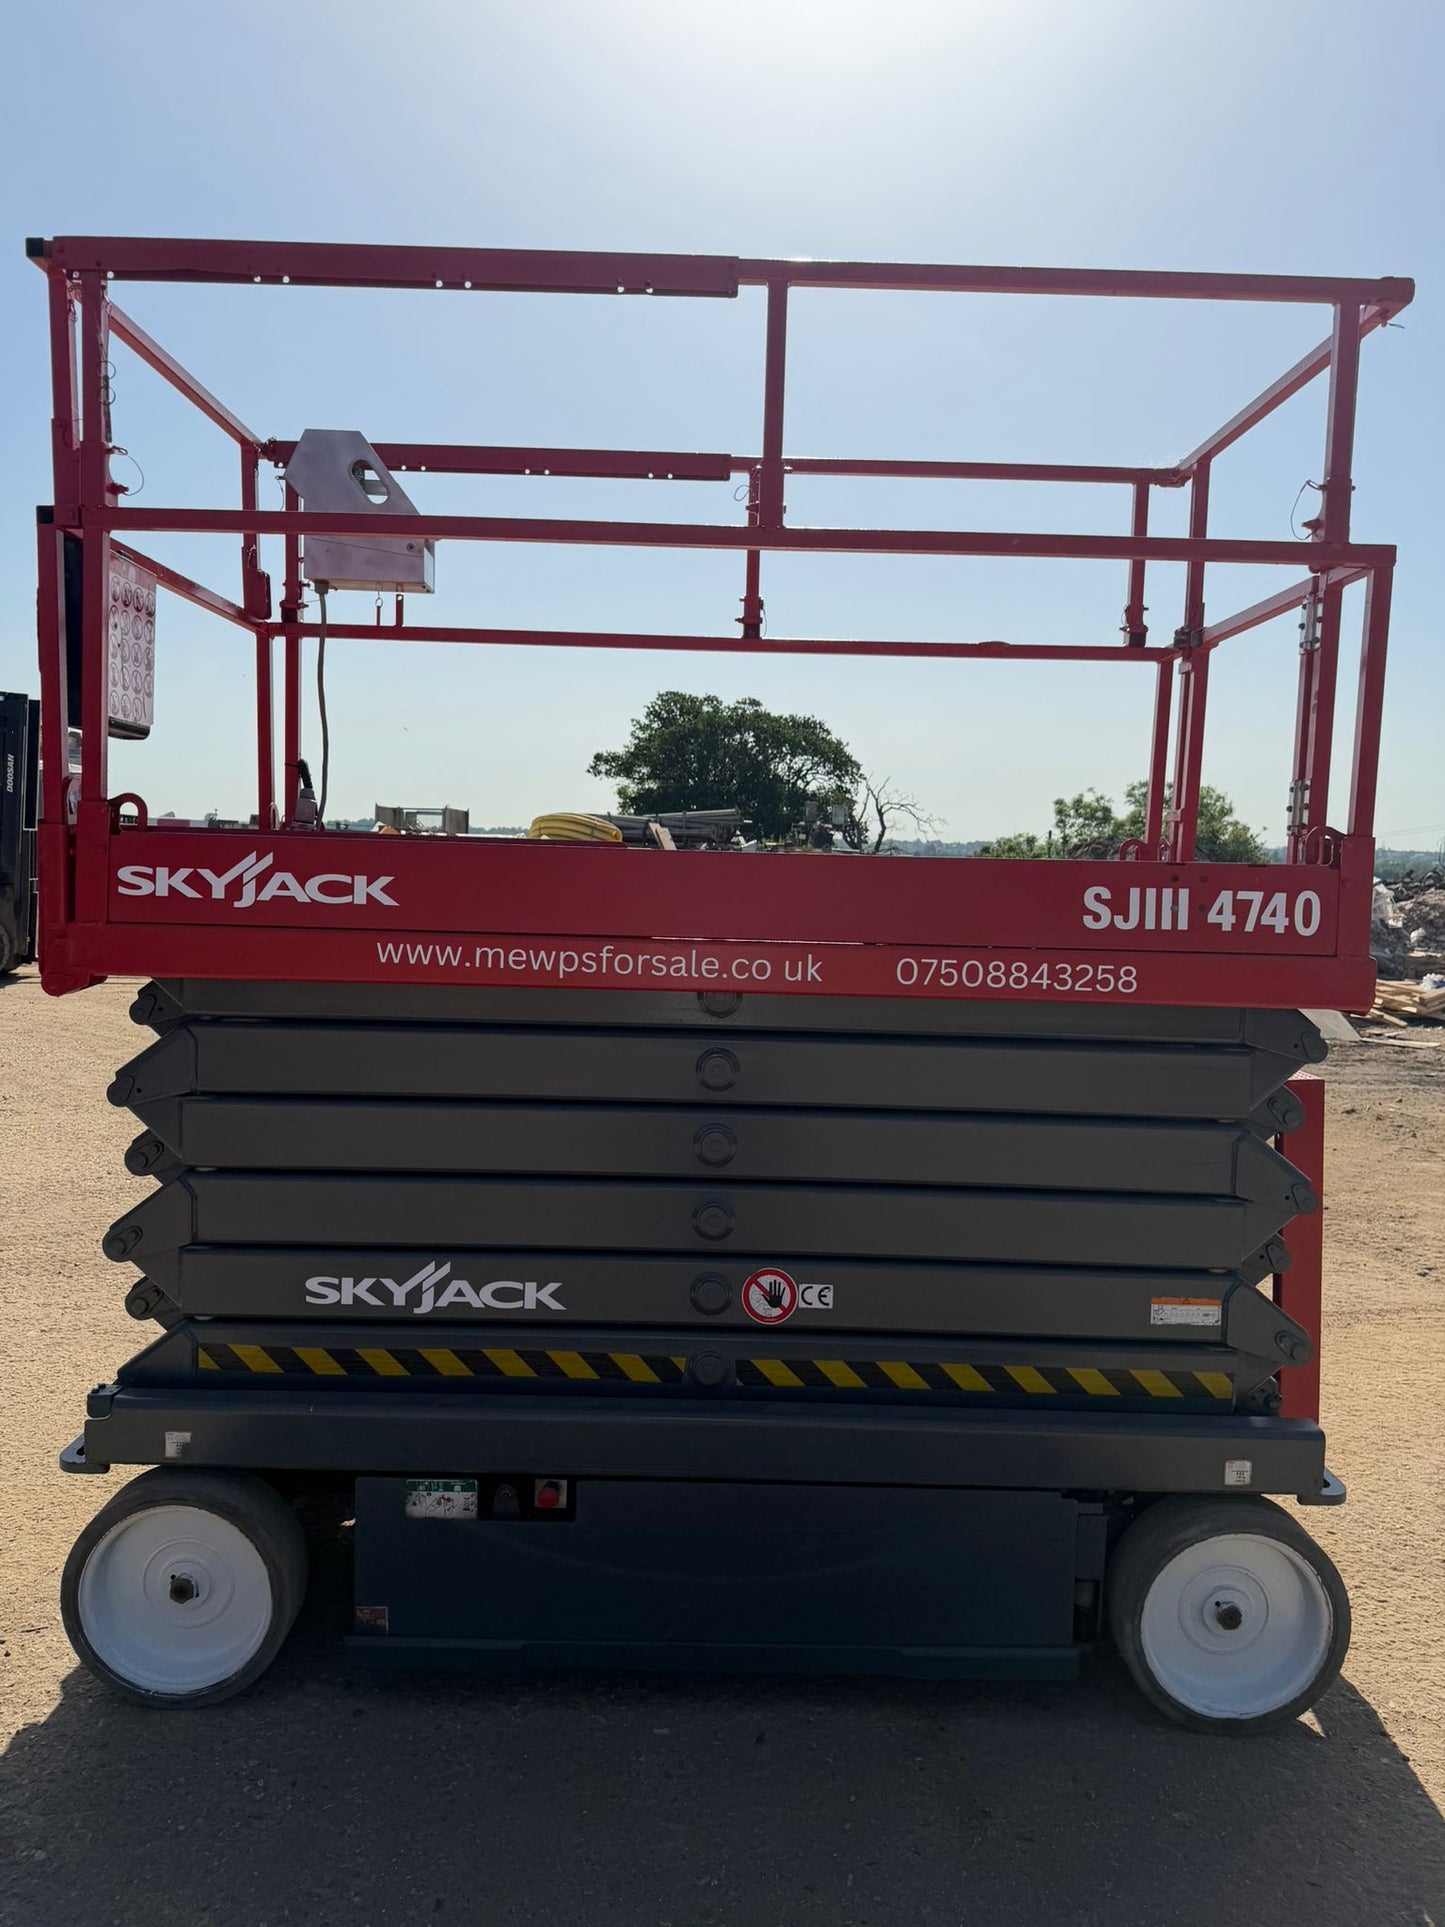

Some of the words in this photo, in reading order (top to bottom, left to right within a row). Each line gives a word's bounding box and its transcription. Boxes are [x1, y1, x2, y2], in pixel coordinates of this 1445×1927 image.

[117, 851, 400, 908] SKYJACK
[1083, 886, 1189, 931] SJIII
[1207, 890, 1321, 936] 4740
[376, 940, 772, 980] www.mewpsforsale.co
[785, 953, 823, 982] uk
[896, 957, 1138, 993] 07508843258
[305, 1261, 567, 1314] SKYJACK
